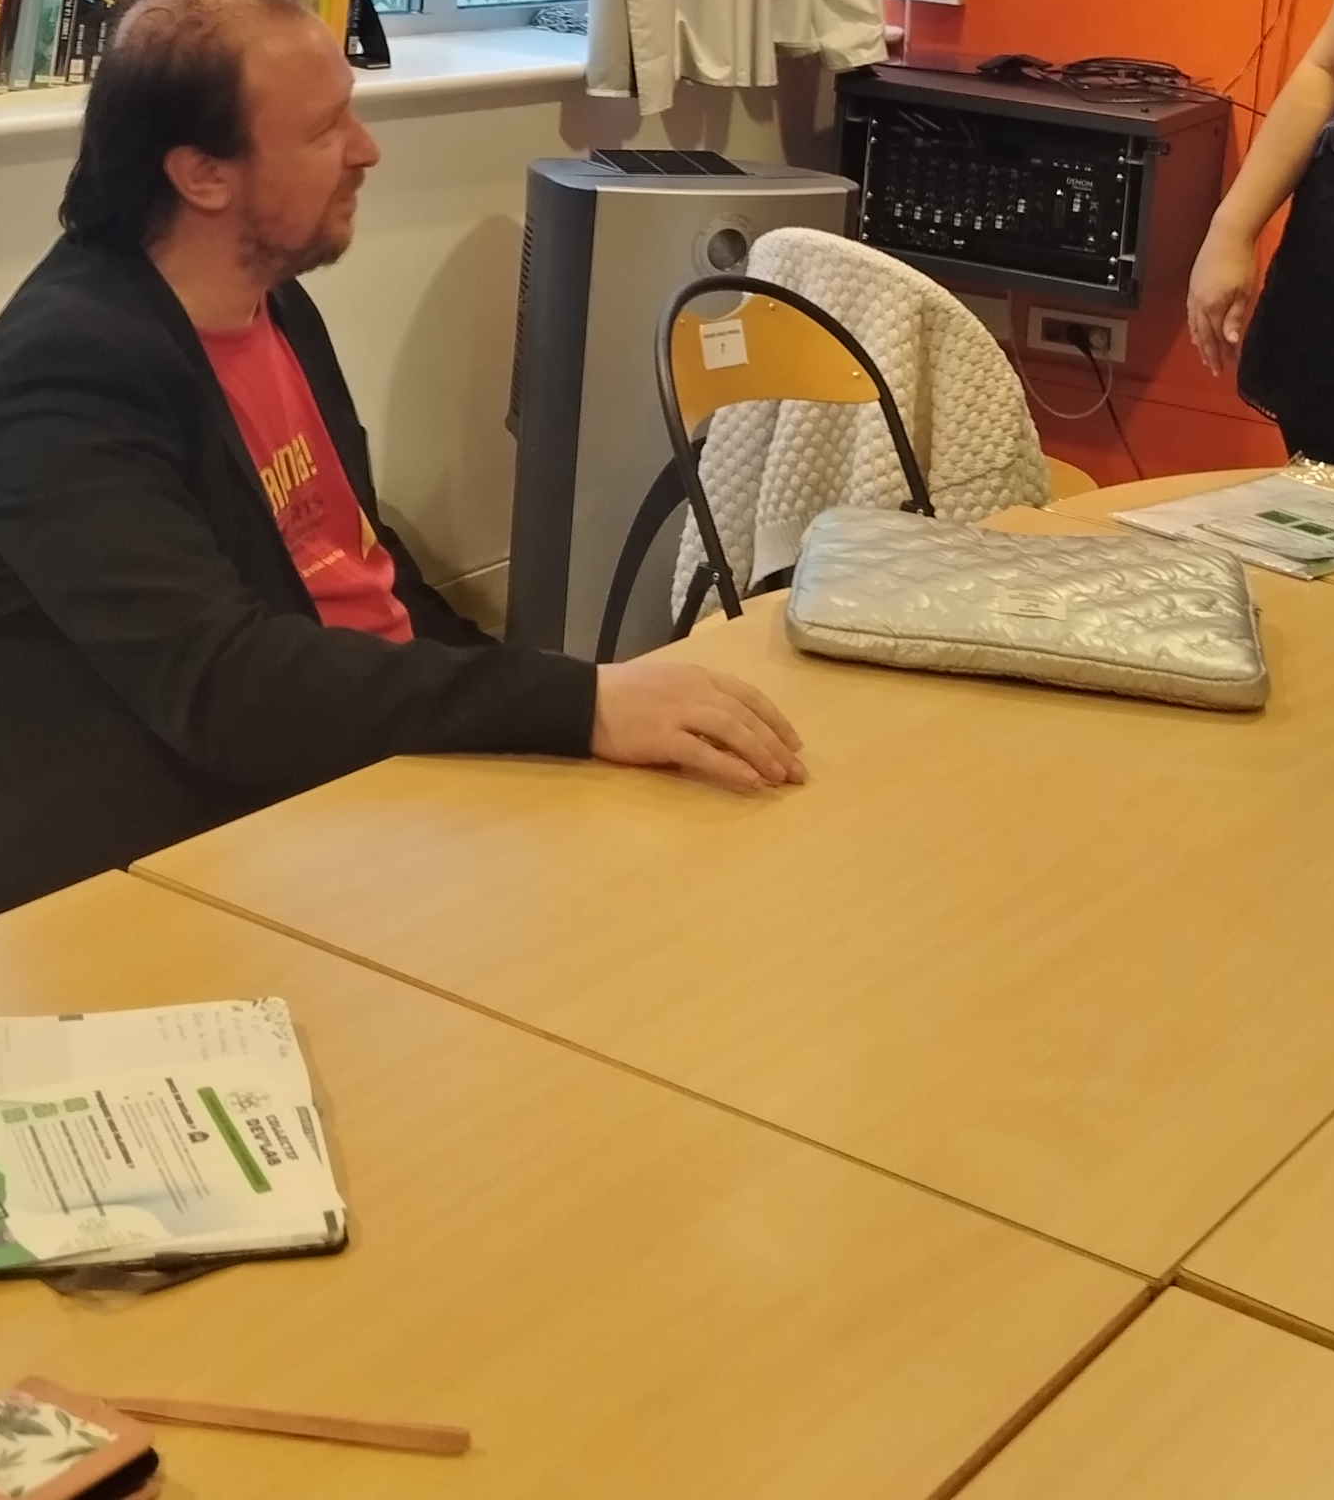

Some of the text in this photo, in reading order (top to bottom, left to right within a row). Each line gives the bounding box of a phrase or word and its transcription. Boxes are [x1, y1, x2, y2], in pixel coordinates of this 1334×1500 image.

[1066, 177, 1093, 187] DENON
[244, 1115, 283, 1169] DEV'LAB
[264, 1113, 300, 1164] COLLECTIF
